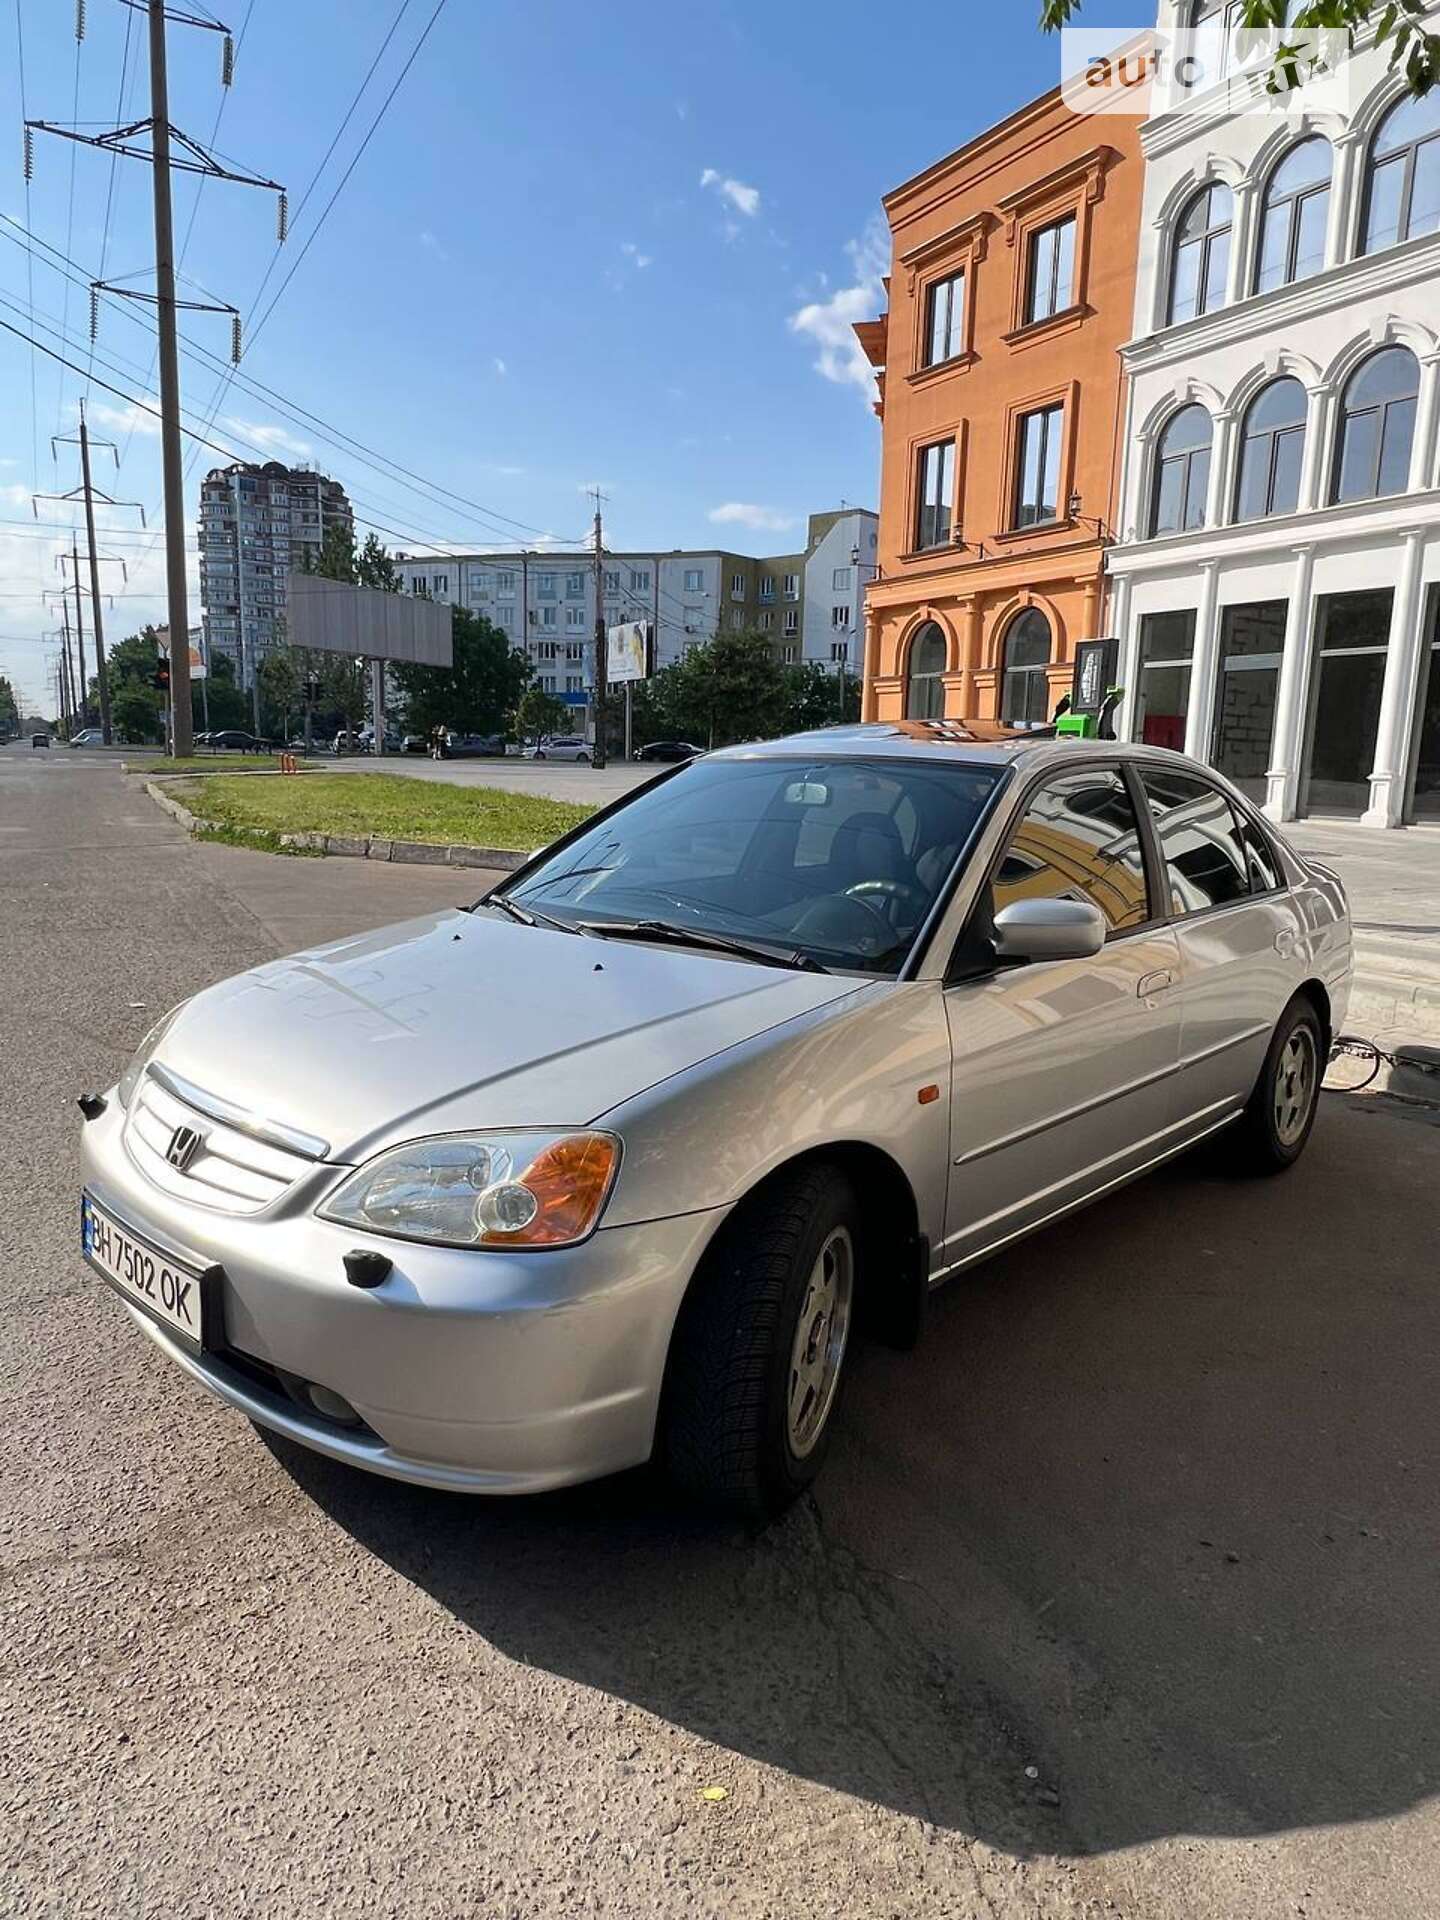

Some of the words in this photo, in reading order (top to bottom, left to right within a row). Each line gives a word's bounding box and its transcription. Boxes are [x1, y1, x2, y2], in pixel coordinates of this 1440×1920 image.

[92, 1213, 111, 1264] BH
[114, 1233, 156, 1300] 7502
[161, 1268, 192, 1325] OK
